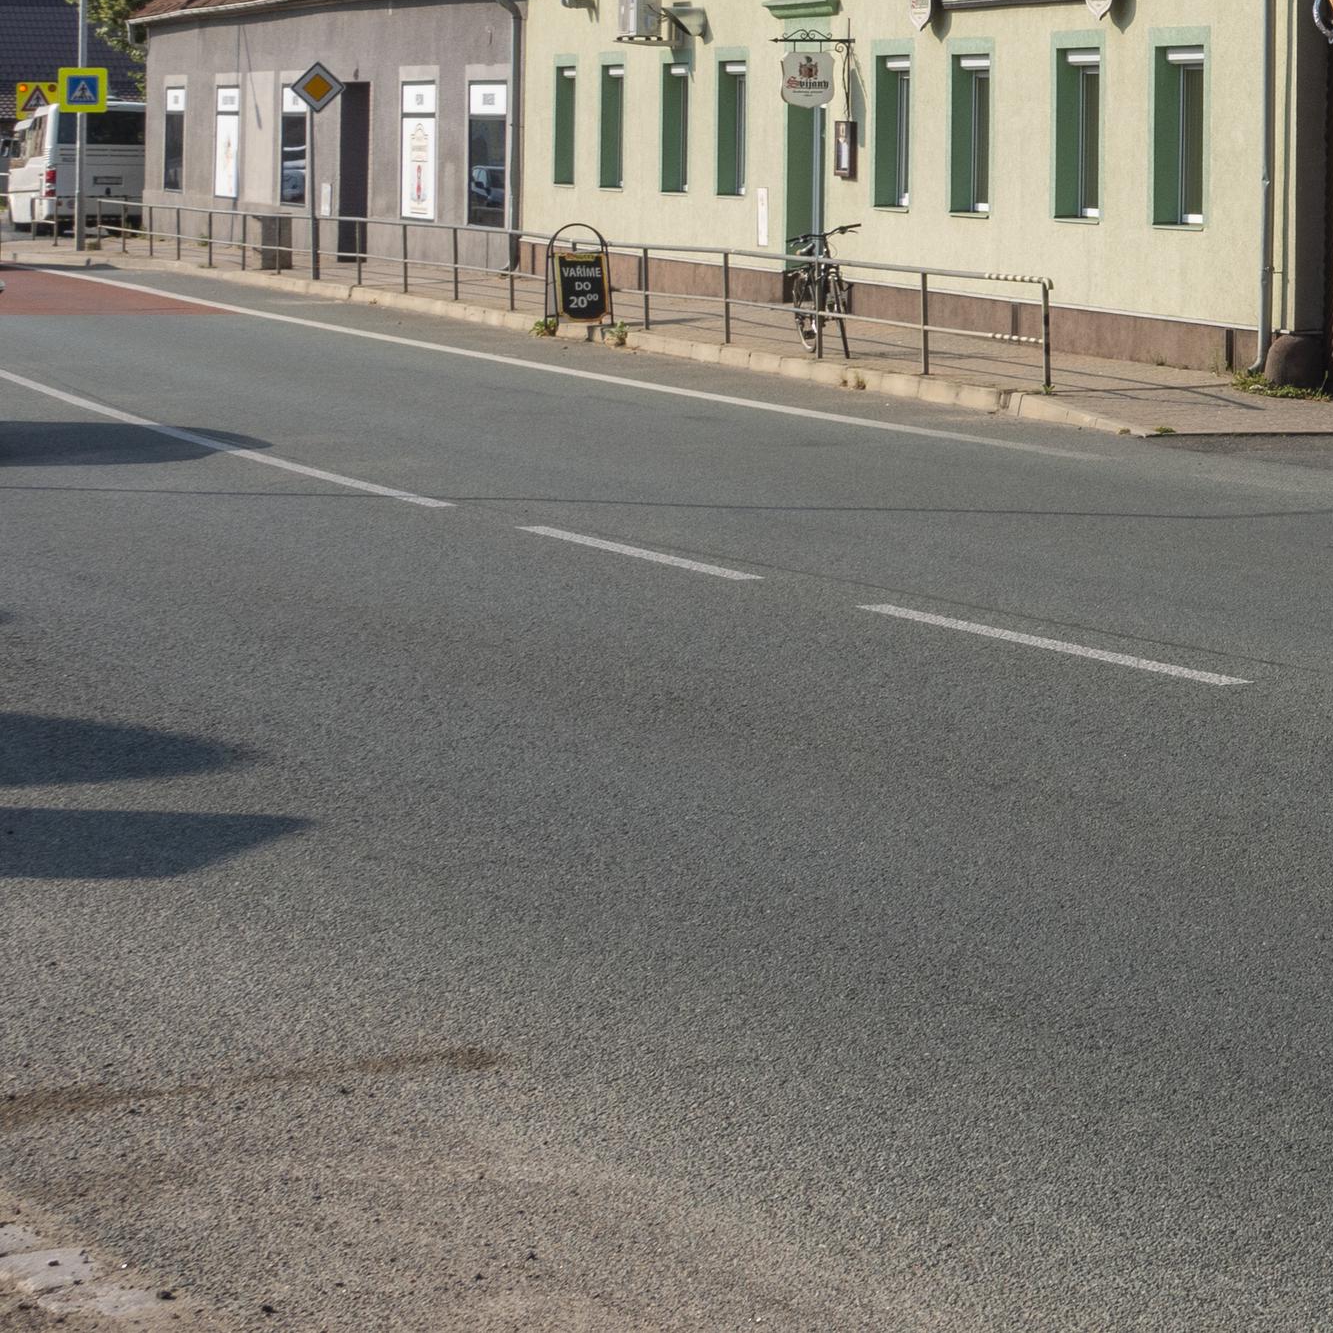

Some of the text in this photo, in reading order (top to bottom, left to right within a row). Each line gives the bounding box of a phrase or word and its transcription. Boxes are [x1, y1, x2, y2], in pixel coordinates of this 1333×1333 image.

[786, 75, 829, 89] Svijany
[561, 264, 602, 278] VAŘÍME
[574, 281, 592, 291] DO
